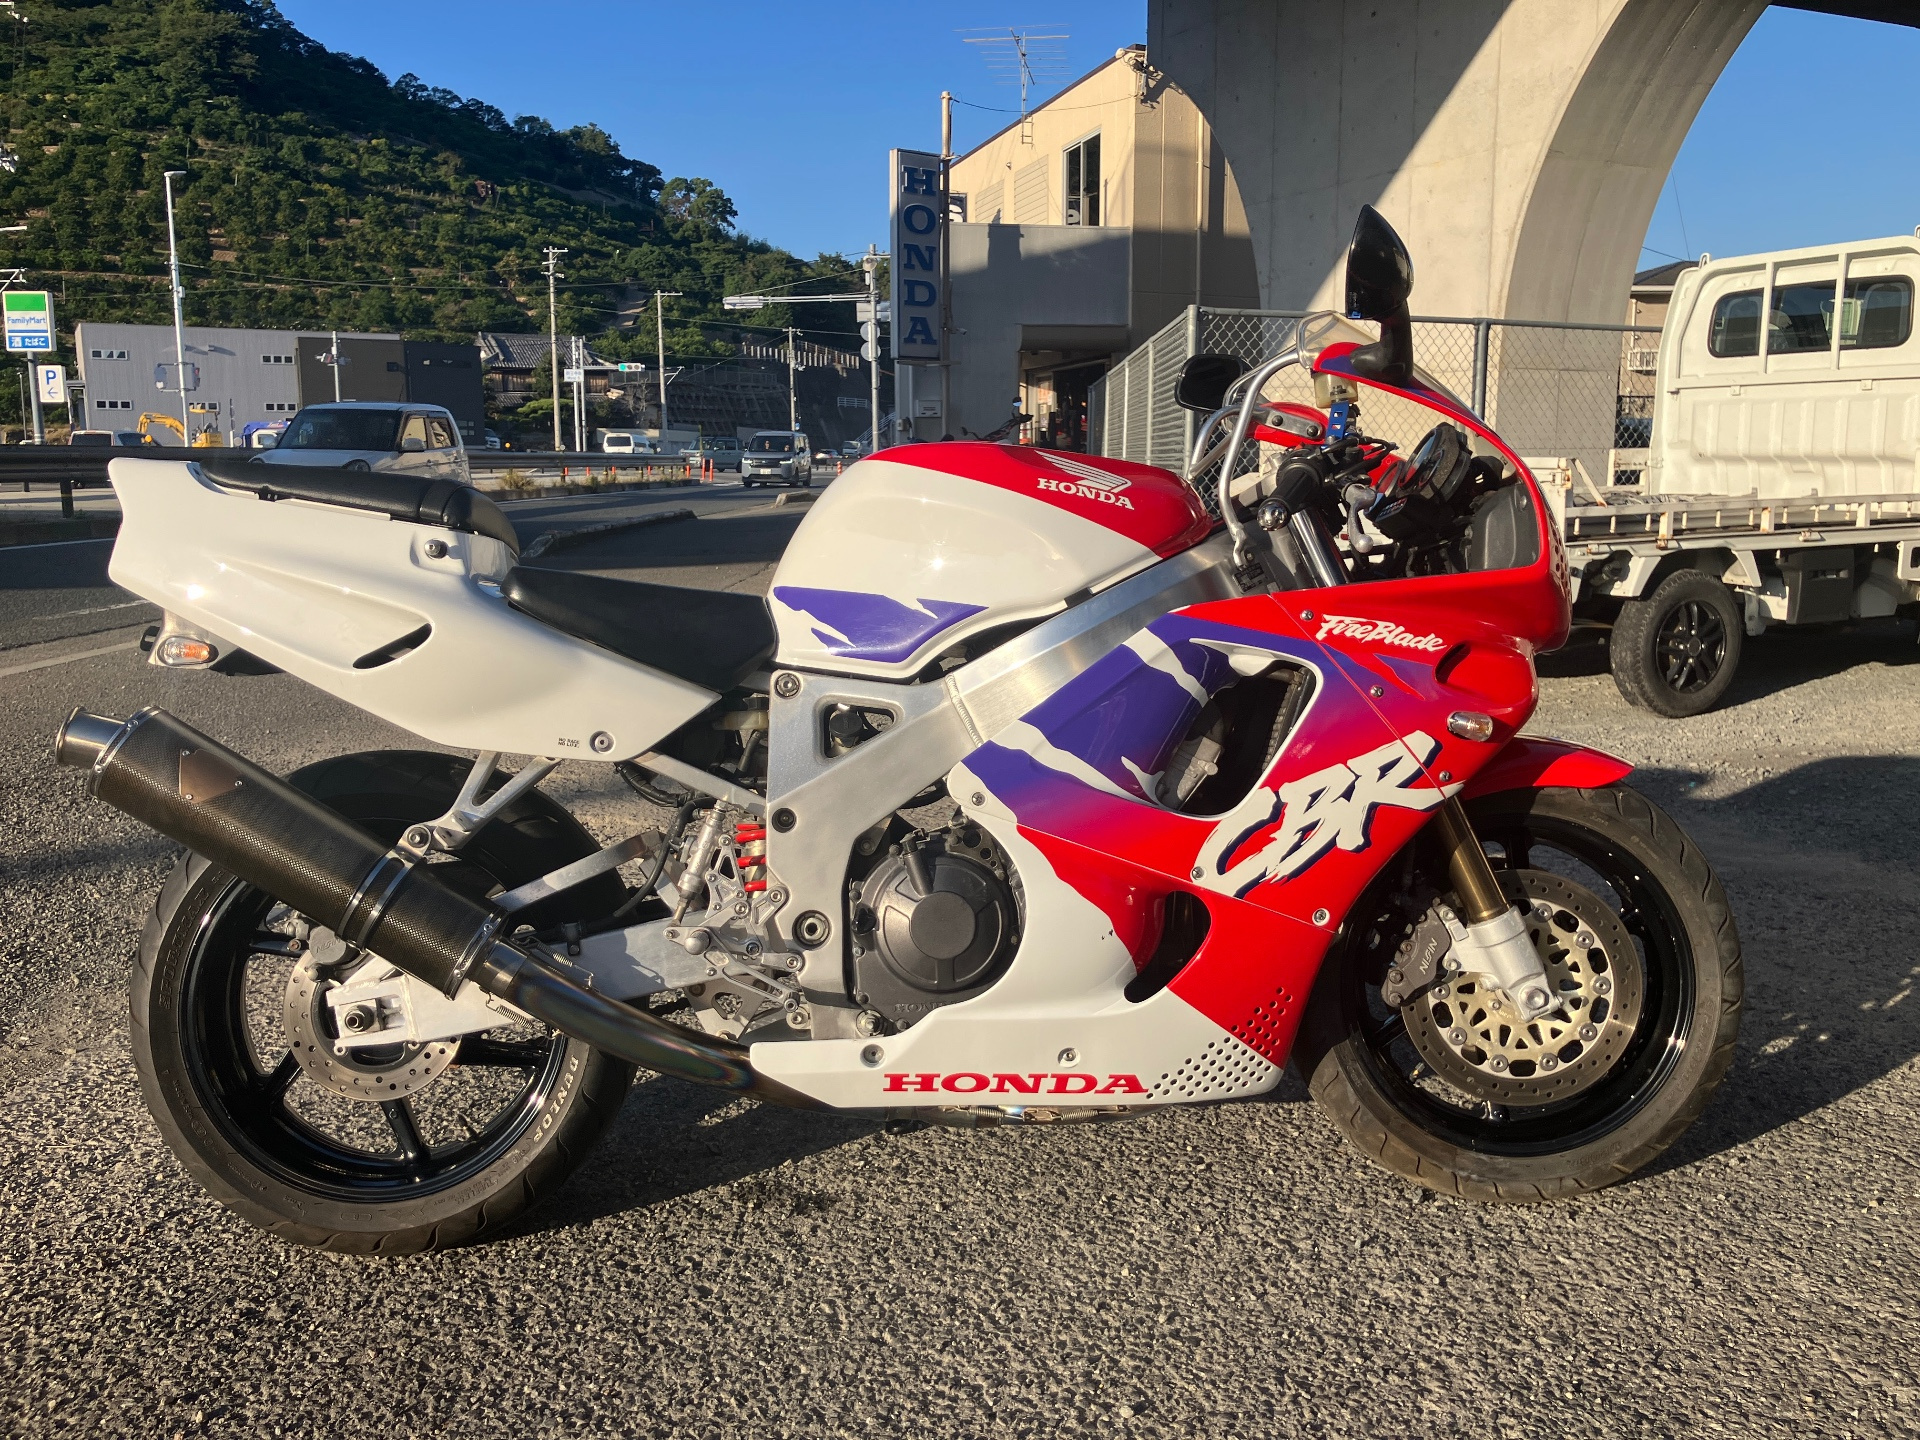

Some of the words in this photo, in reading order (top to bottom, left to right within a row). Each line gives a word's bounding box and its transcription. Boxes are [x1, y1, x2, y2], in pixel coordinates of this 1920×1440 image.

[901, 165, 937, 345] HONDA
[7, 316, 46, 325] FamilyMart
[11, 337, 22, 347] 酒
[24, 338, 46, 346] たばこ
[45, 370, 56, 385] P
[1037, 478, 1135, 510] HONDA
[1315, 613, 1447, 652] FireBlade
[1189, 729, 1467, 900] CBR
[533, 1054, 579, 1143] DUNLOP
[882, 1072, 1149, 1095] HONDA
